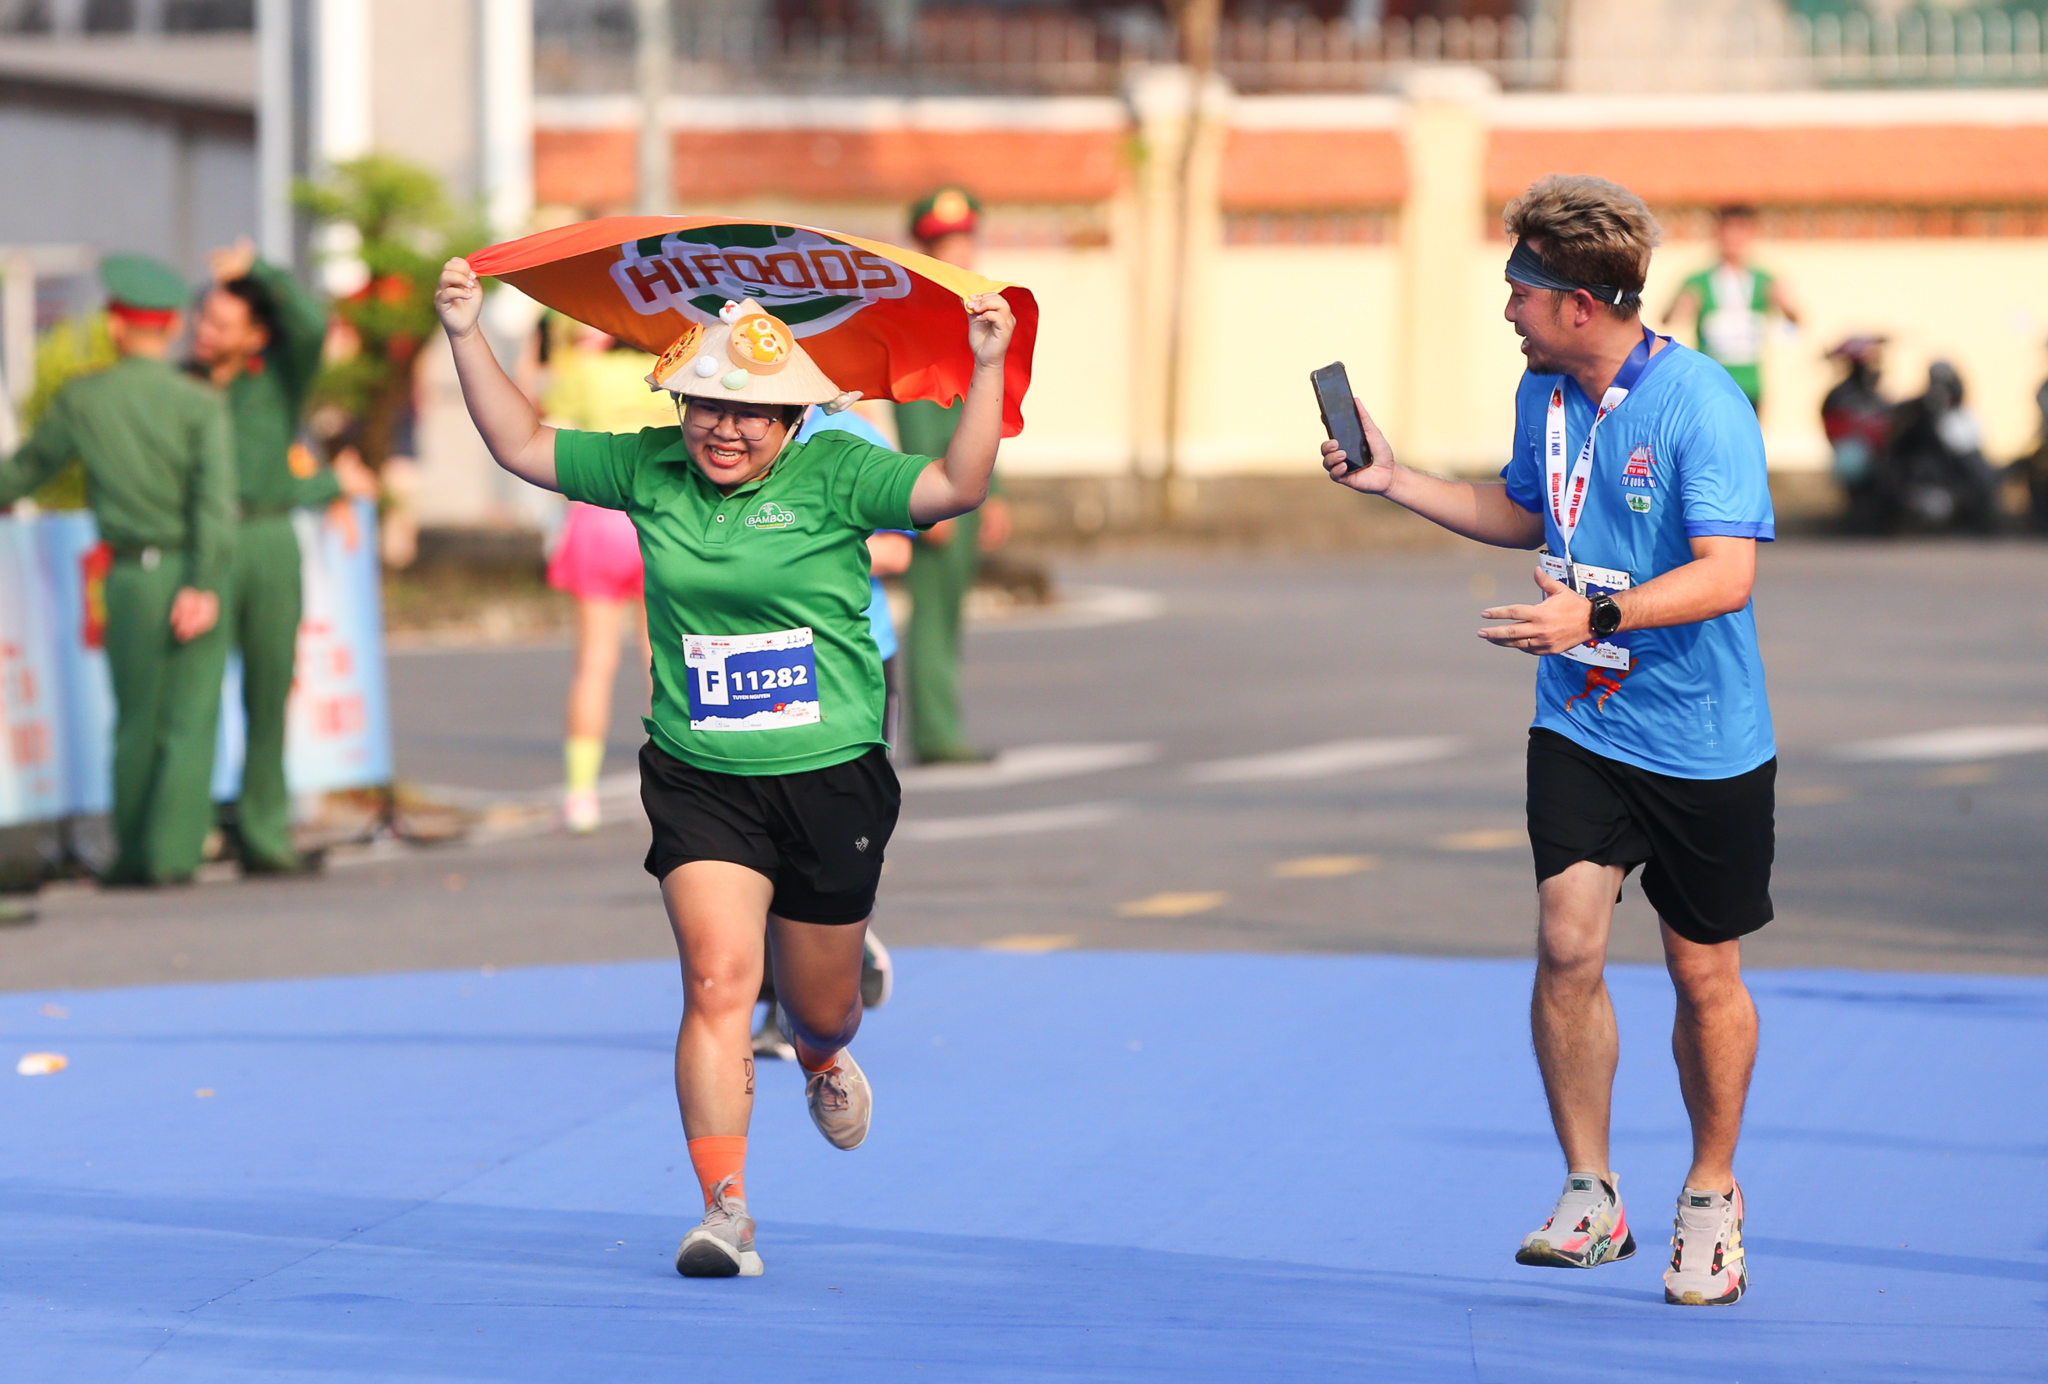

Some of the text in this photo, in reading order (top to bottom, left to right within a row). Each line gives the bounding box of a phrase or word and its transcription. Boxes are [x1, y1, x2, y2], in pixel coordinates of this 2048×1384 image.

[624, 249, 898, 304] HIFOODS
[1552, 443, 1560, 456] KM
[748, 513, 793, 525] BAMBOO
[706, 665, 808, 692] F 11282
